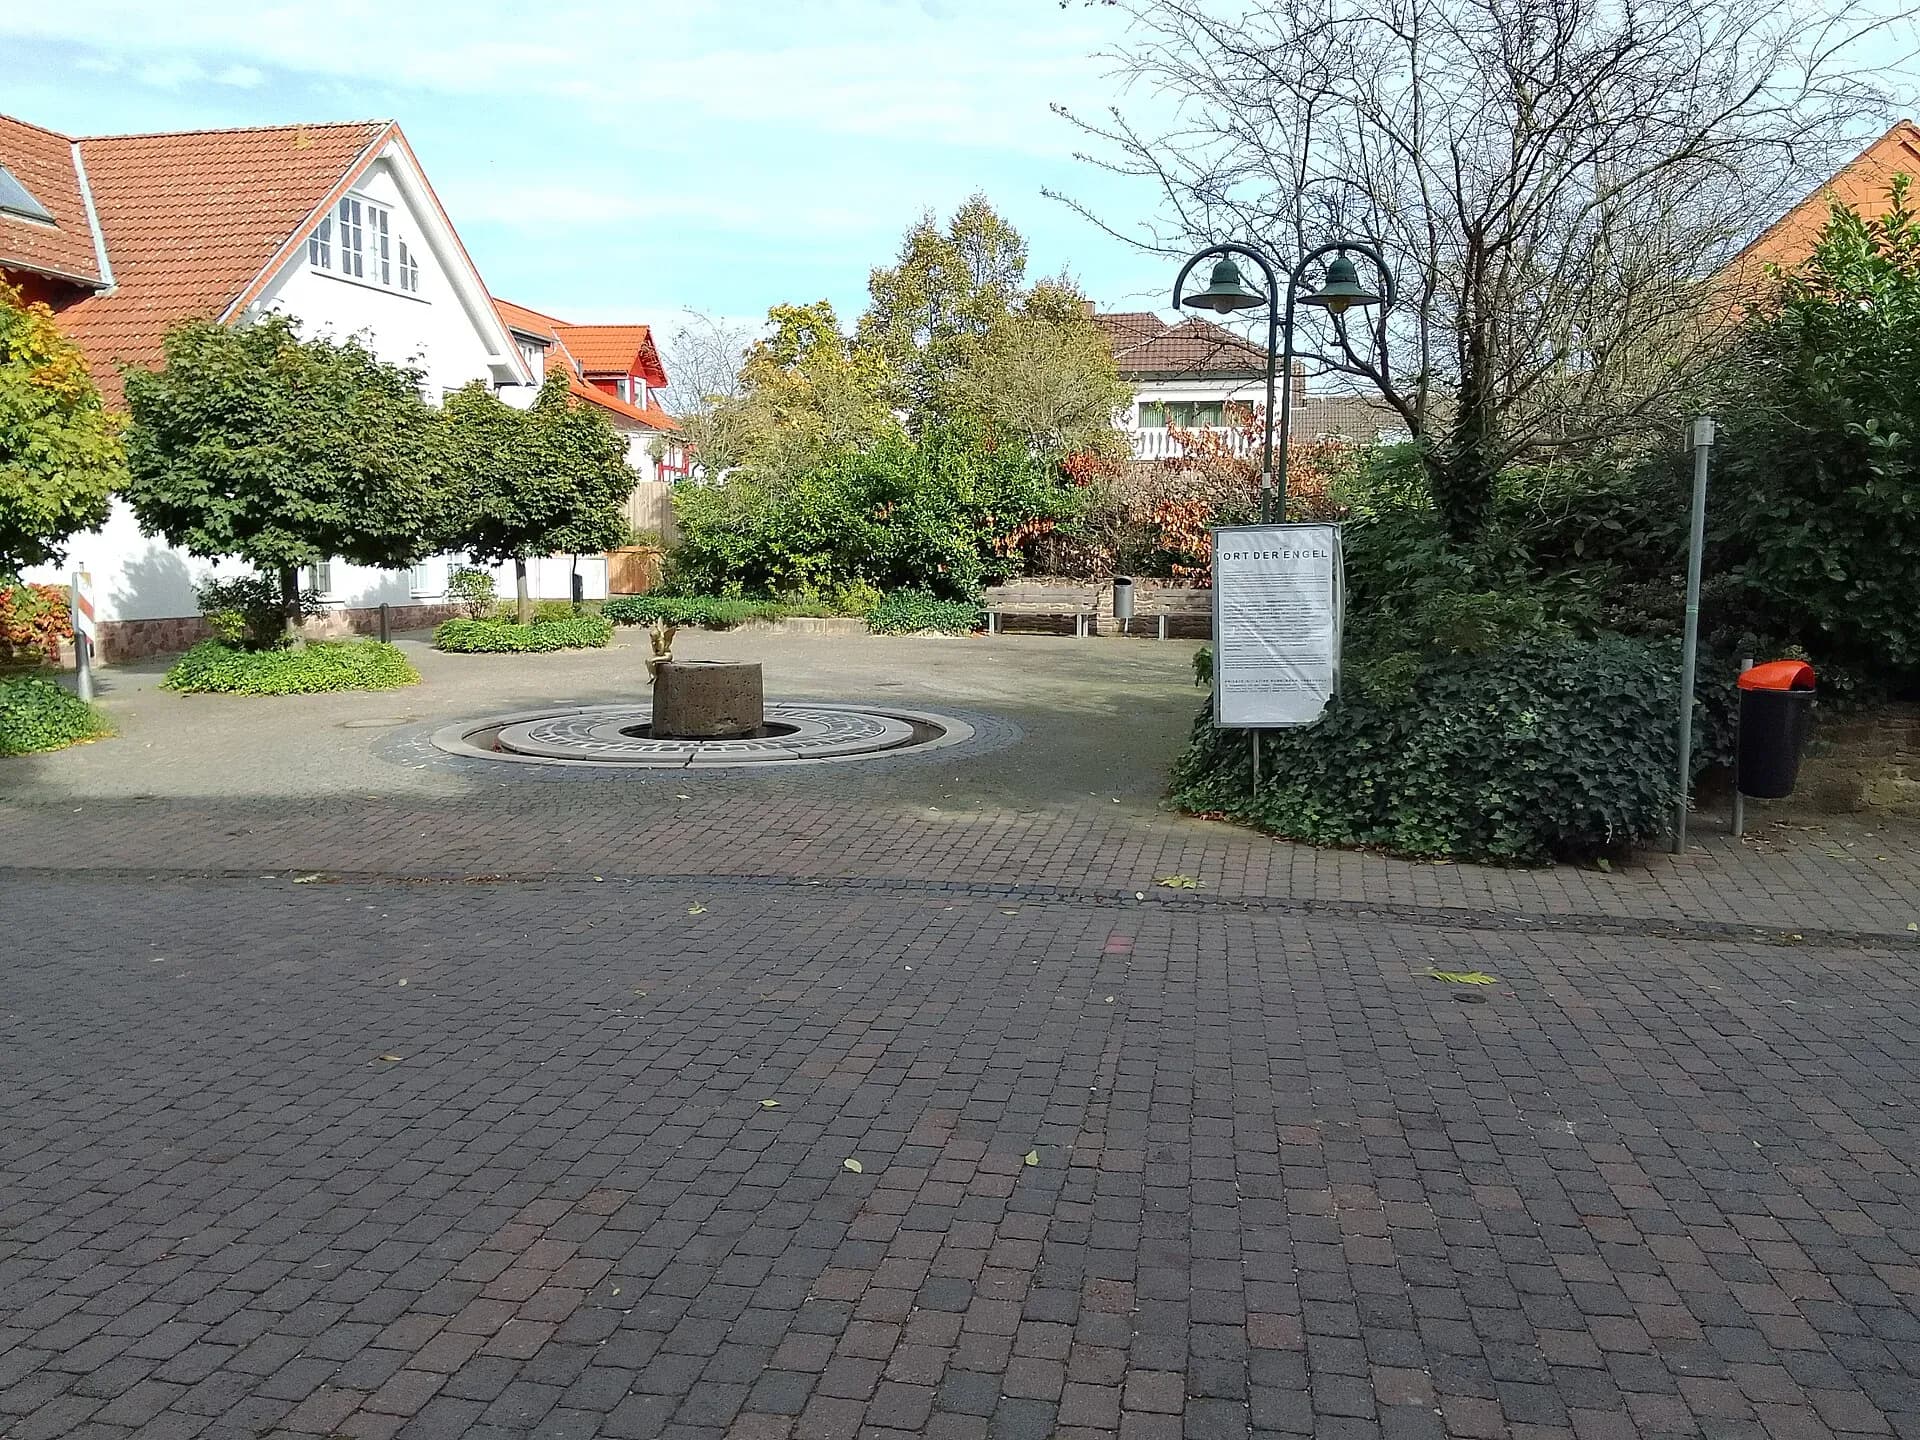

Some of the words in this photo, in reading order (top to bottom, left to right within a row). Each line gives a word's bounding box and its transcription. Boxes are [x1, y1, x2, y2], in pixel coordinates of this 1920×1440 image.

[1223, 552, 1249, 560] ORT
[1253, 551, 1279, 560] DER
[1283, 550, 1328, 559] ENGEL
